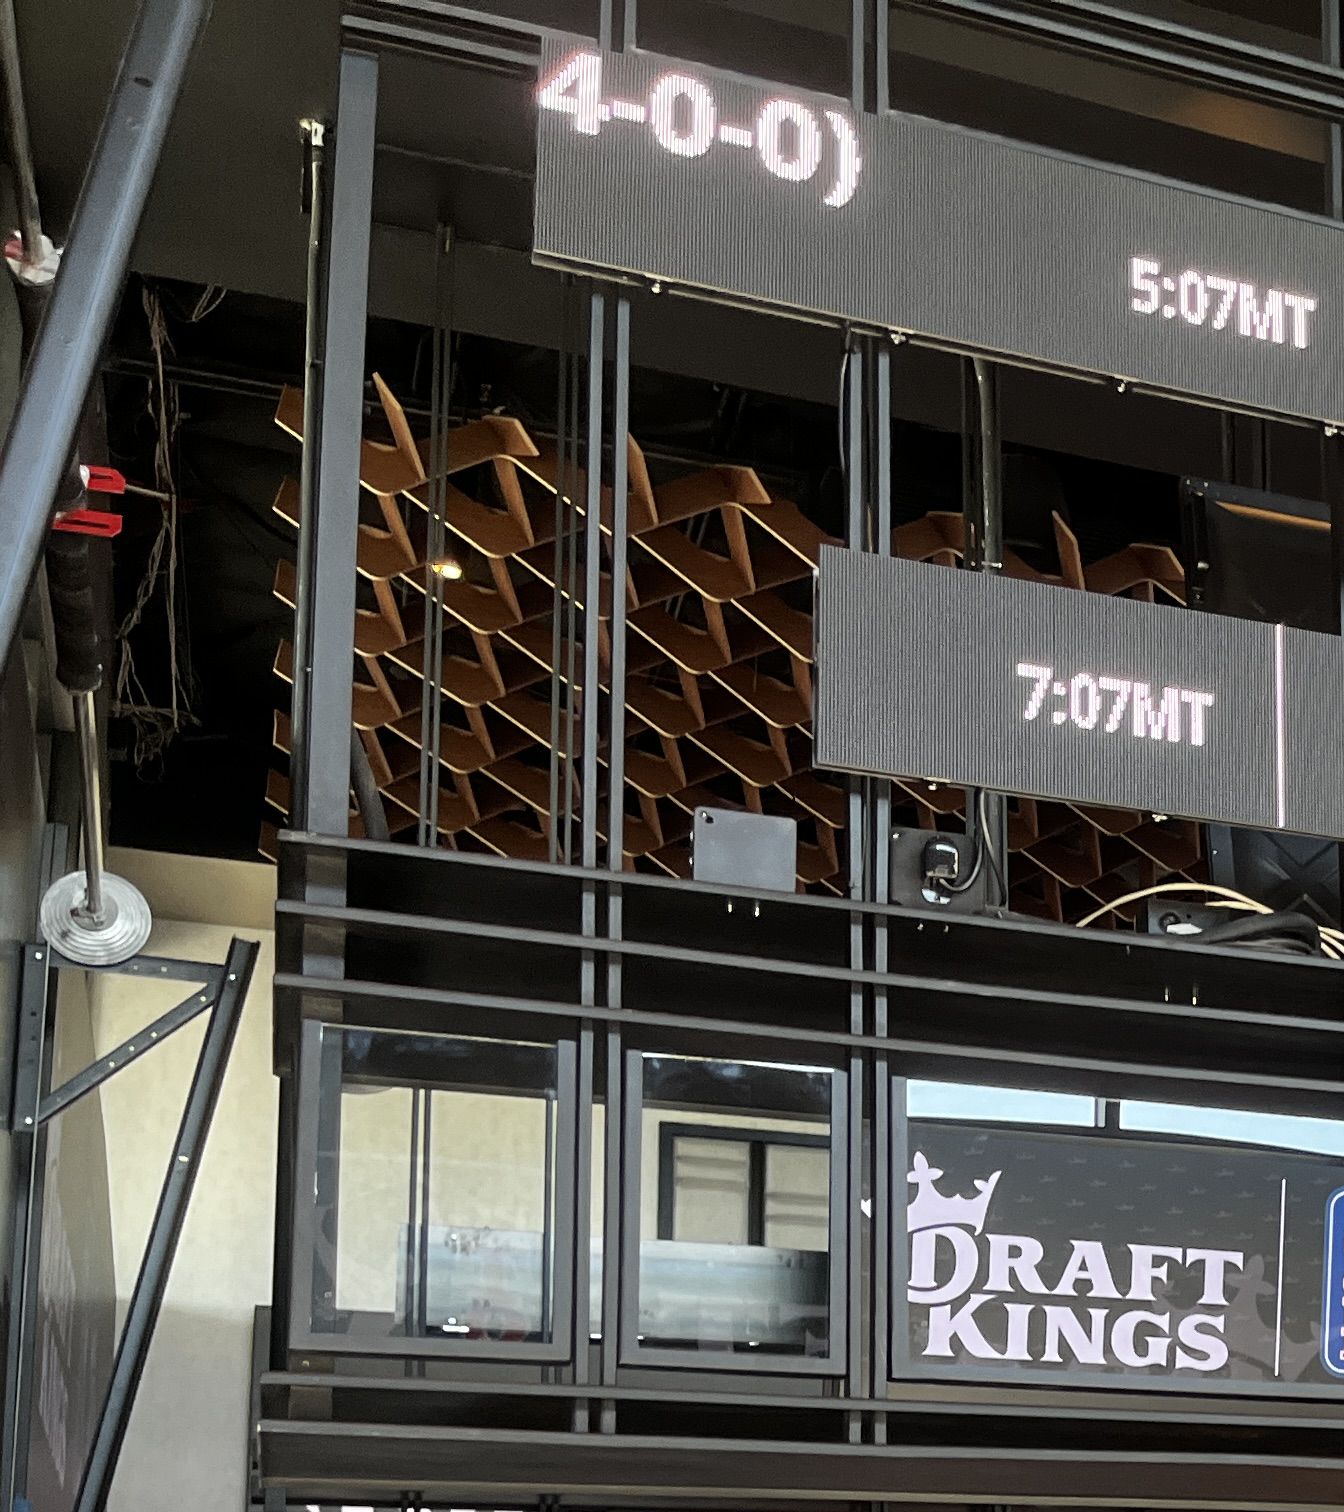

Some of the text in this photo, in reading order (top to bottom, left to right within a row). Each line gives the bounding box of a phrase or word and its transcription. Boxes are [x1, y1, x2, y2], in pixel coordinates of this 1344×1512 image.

[1130, 256, 1317, 350] 5:07MT
[1016, 661, 1215, 747] 7:07MT
[907, 1223, 1244, 1307] DRAFT
[921, 1293, 1231, 1372] KINGS
